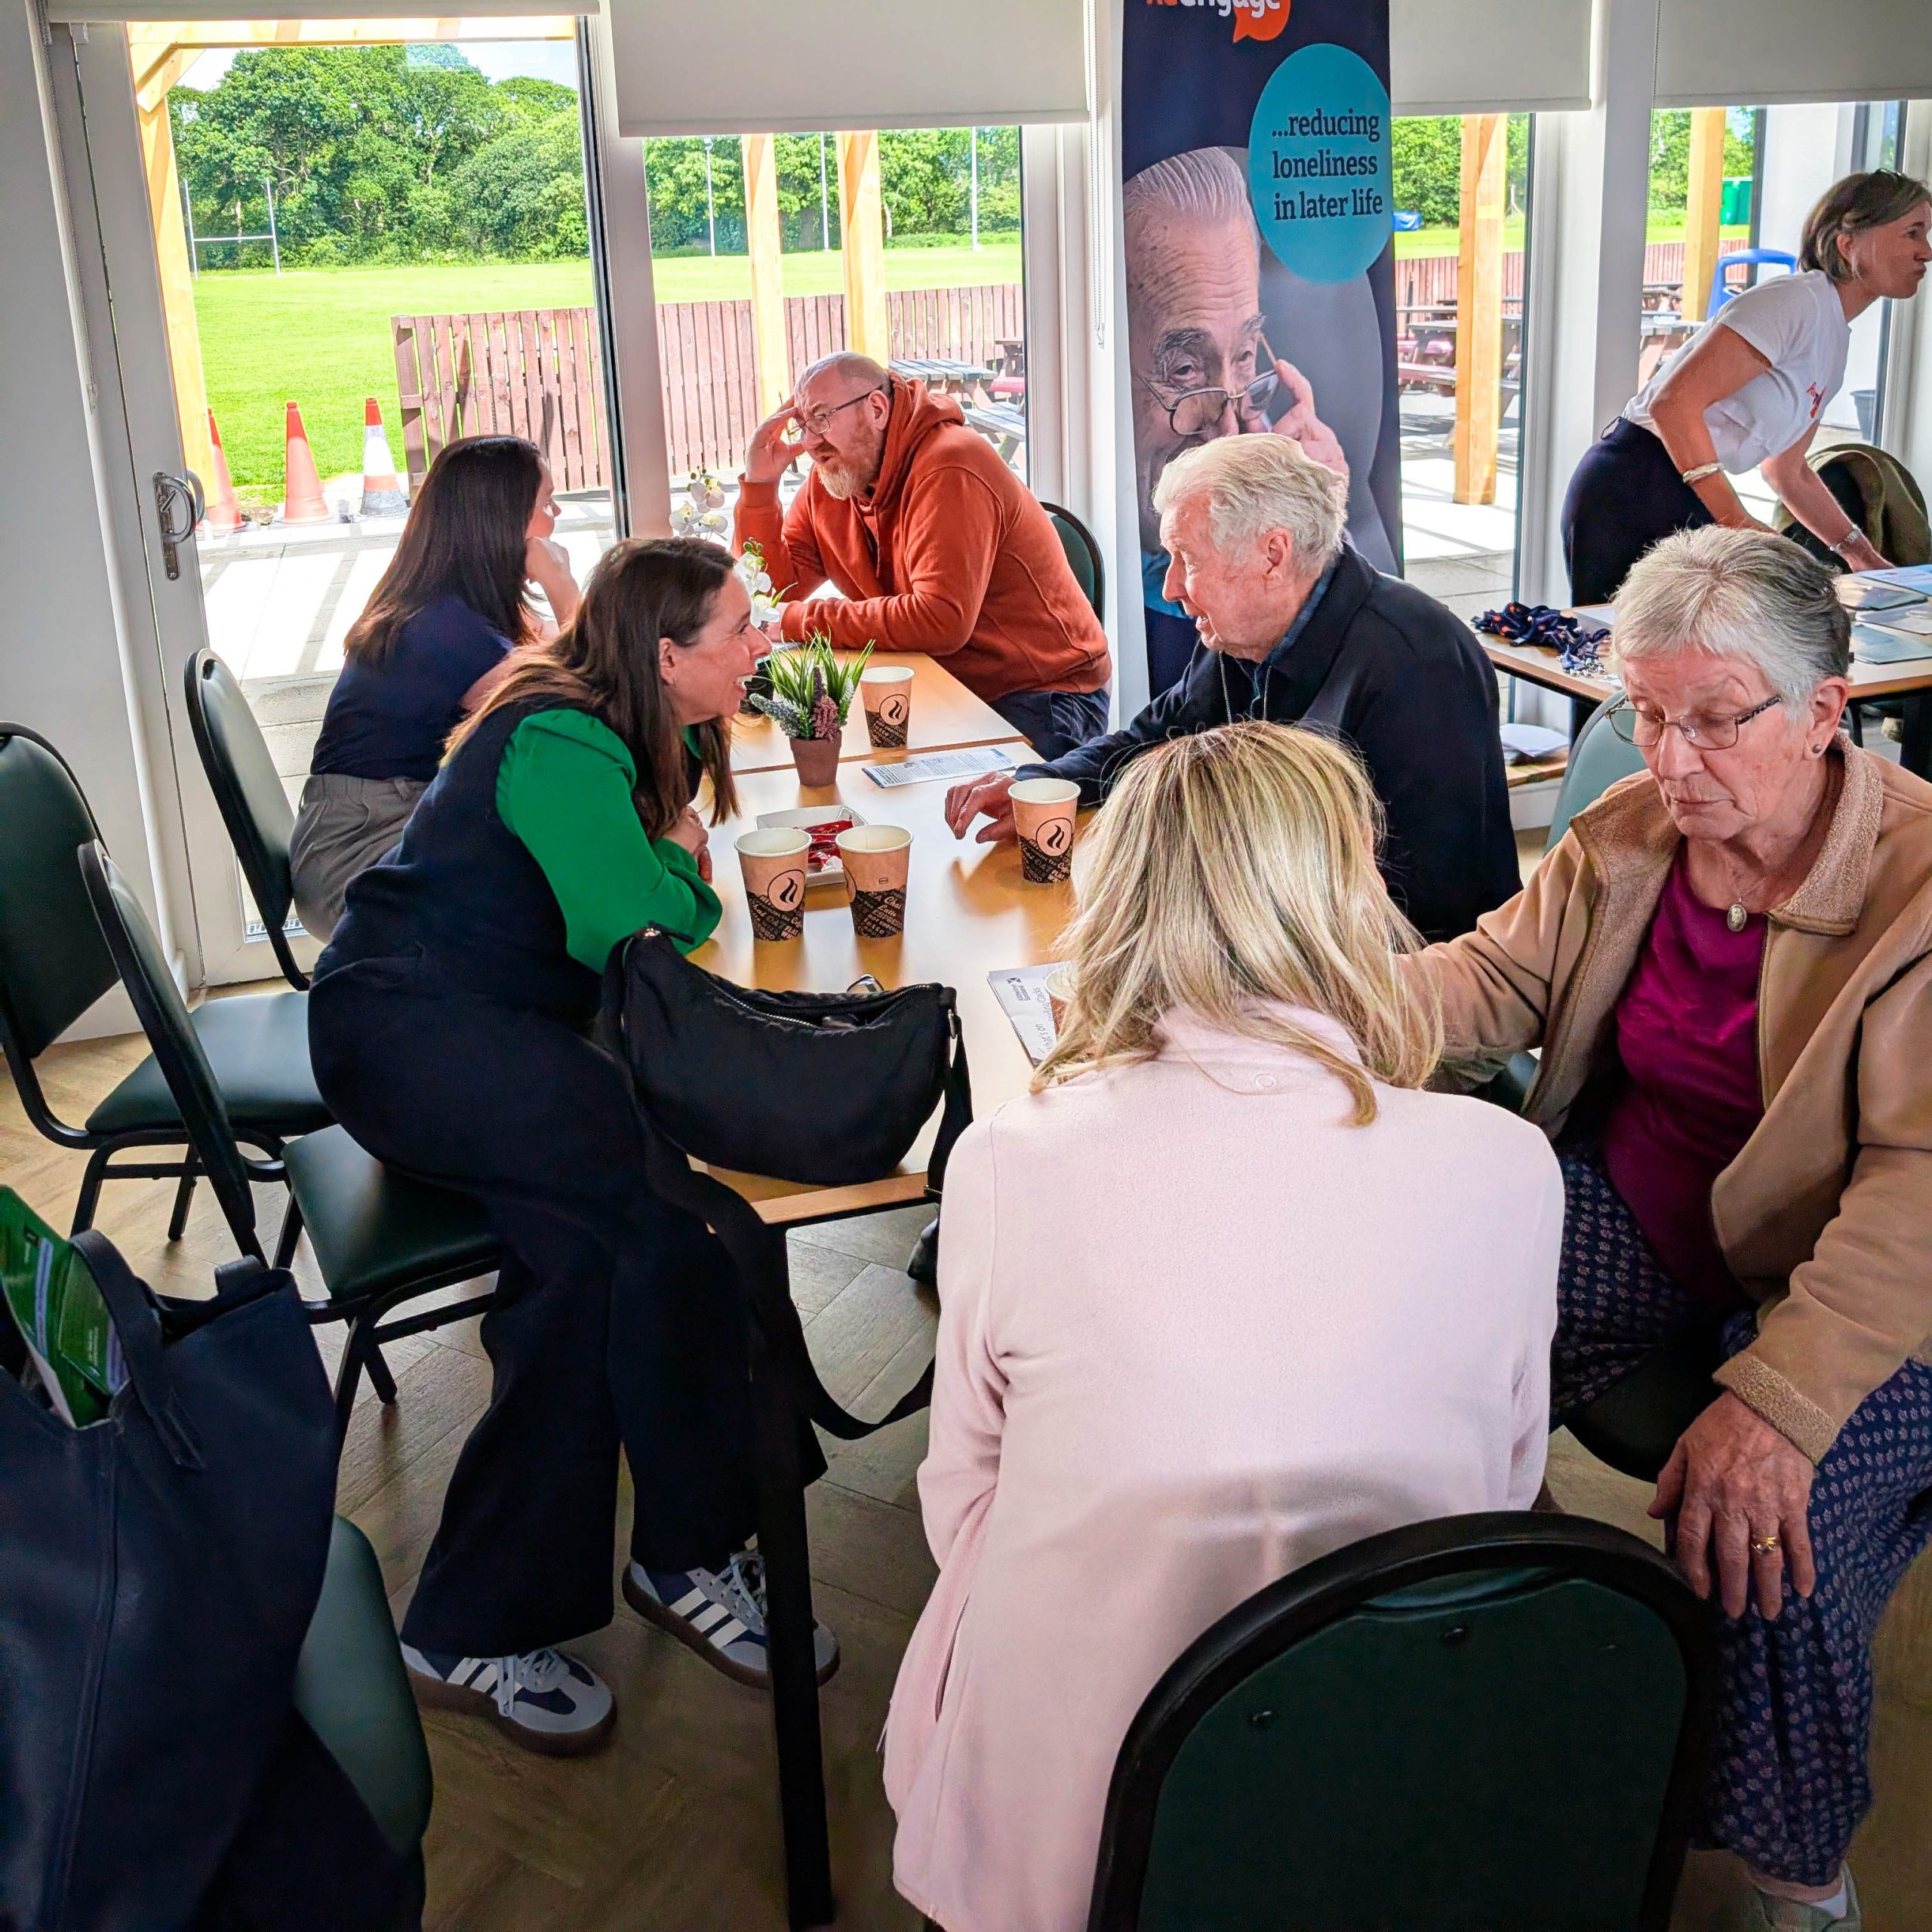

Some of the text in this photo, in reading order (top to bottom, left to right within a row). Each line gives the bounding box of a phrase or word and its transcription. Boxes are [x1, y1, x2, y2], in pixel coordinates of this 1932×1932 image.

[1272, 108, 1380, 142] ...reducing
[1272, 149, 1378, 179] loneliness
[1274, 187, 1383, 220] in later life
[1035, 1023, 1046, 1032] on
